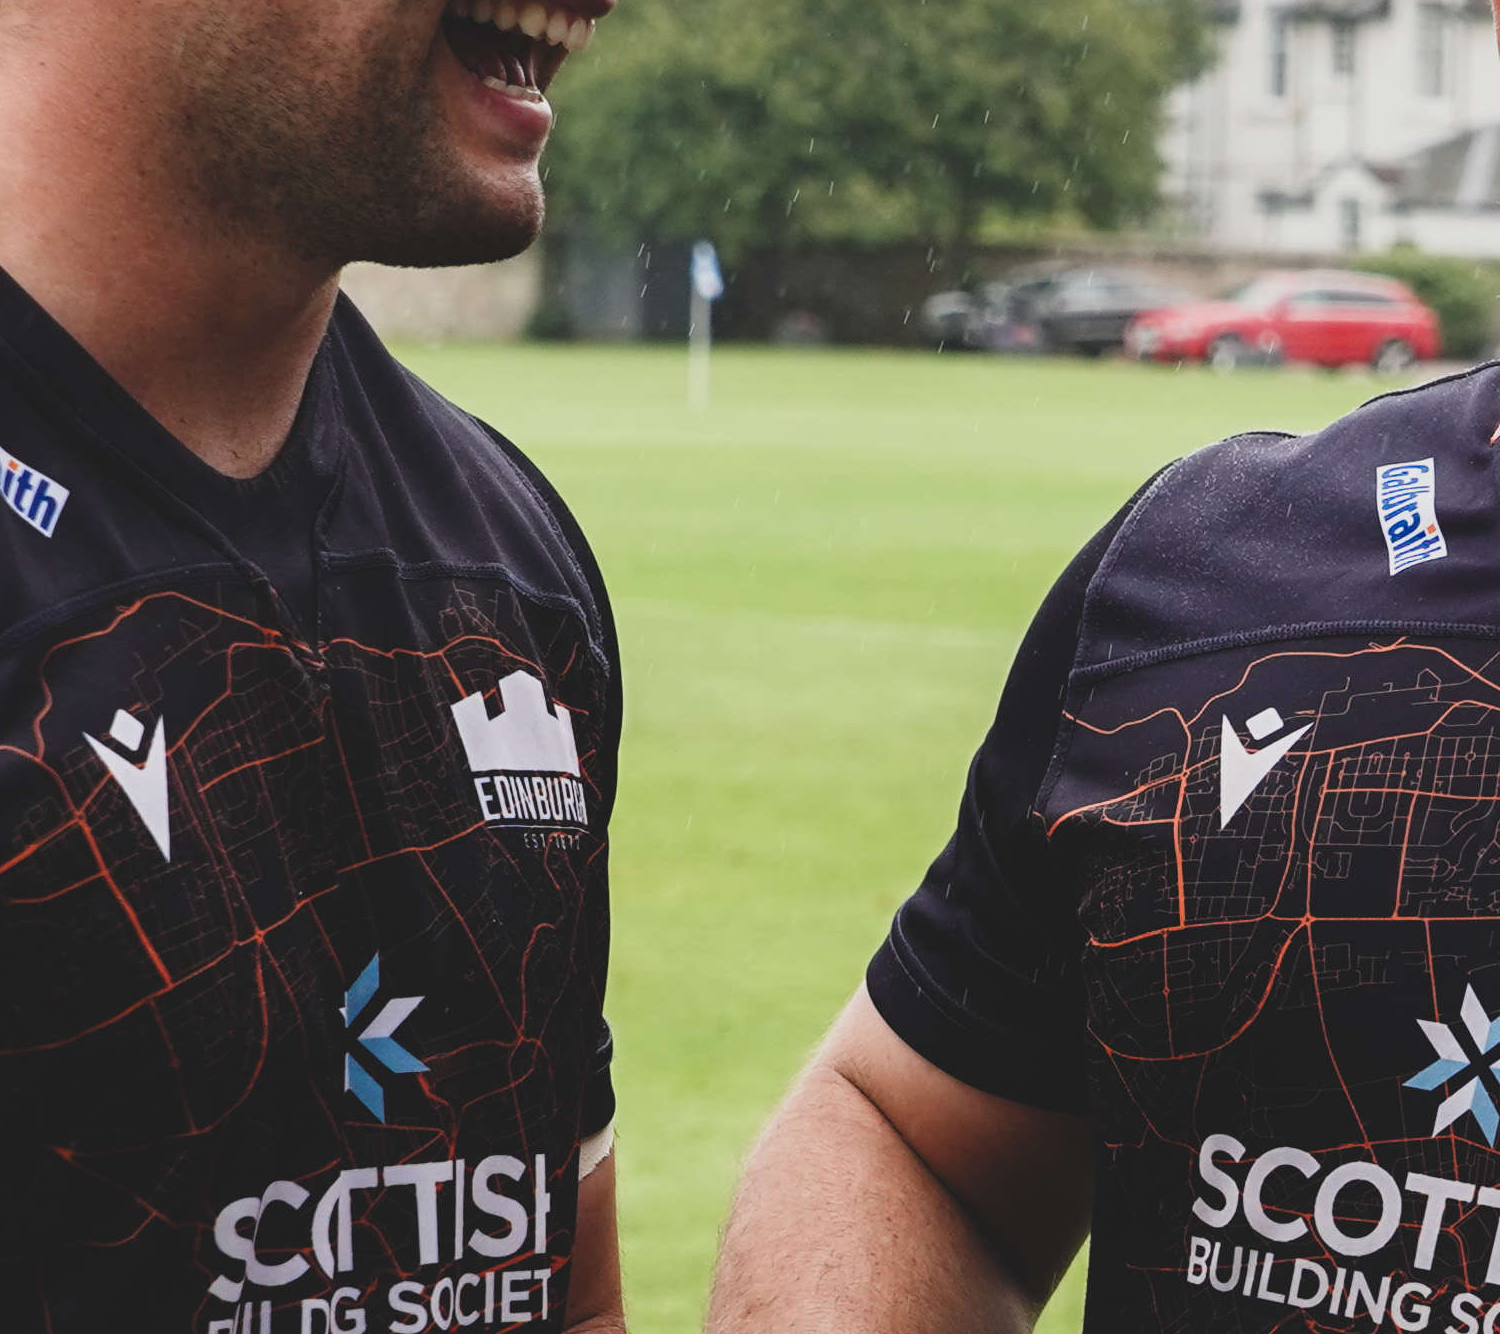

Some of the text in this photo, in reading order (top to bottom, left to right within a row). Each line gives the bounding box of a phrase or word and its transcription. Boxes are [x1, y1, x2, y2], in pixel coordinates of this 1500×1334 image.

[1381, 465, 1442, 570] Galbraith
[387, 1267, 552, 1334] SOCIET
[1186, 1236, 1433, 1332] BUILDING
